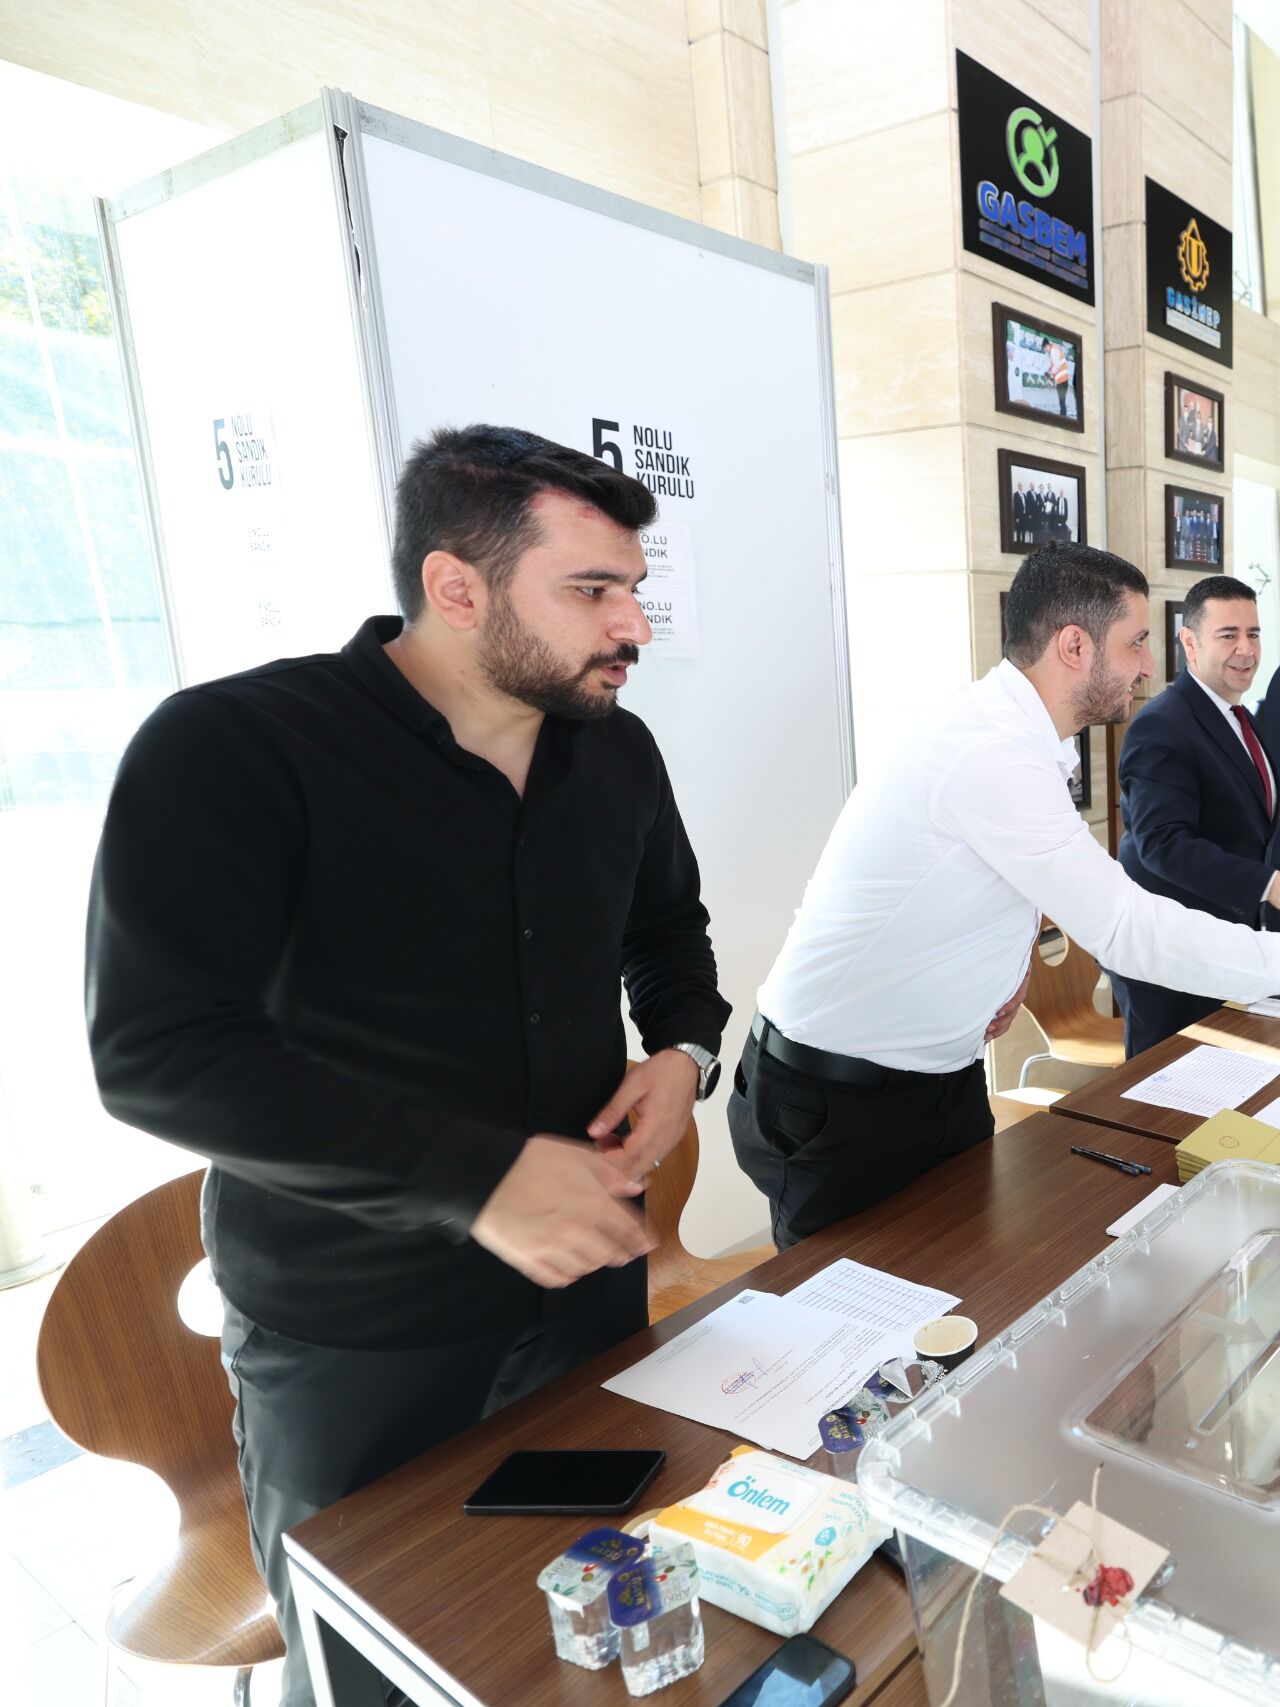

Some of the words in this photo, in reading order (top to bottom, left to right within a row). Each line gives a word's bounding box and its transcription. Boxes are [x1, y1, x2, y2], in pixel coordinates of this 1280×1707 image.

[977, 180, 1088, 267] GASBEM
[231, 414, 253, 437] NOLU
[633, 425, 673, 450] NOLU
[213, 418, 235, 491] 5
[235, 437, 268, 463] SANDIK
[592, 417, 624, 475] 5
[634, 449, 691, 477] SANDIK
[240, 464, 272, 488] KURULU
[641, 534, 668, 546] O.LU
[643, 548, 669, 559] NDIK
[646, 614, 673, 624] NDIK
[727, 1475, 791, 1516] Önlem
